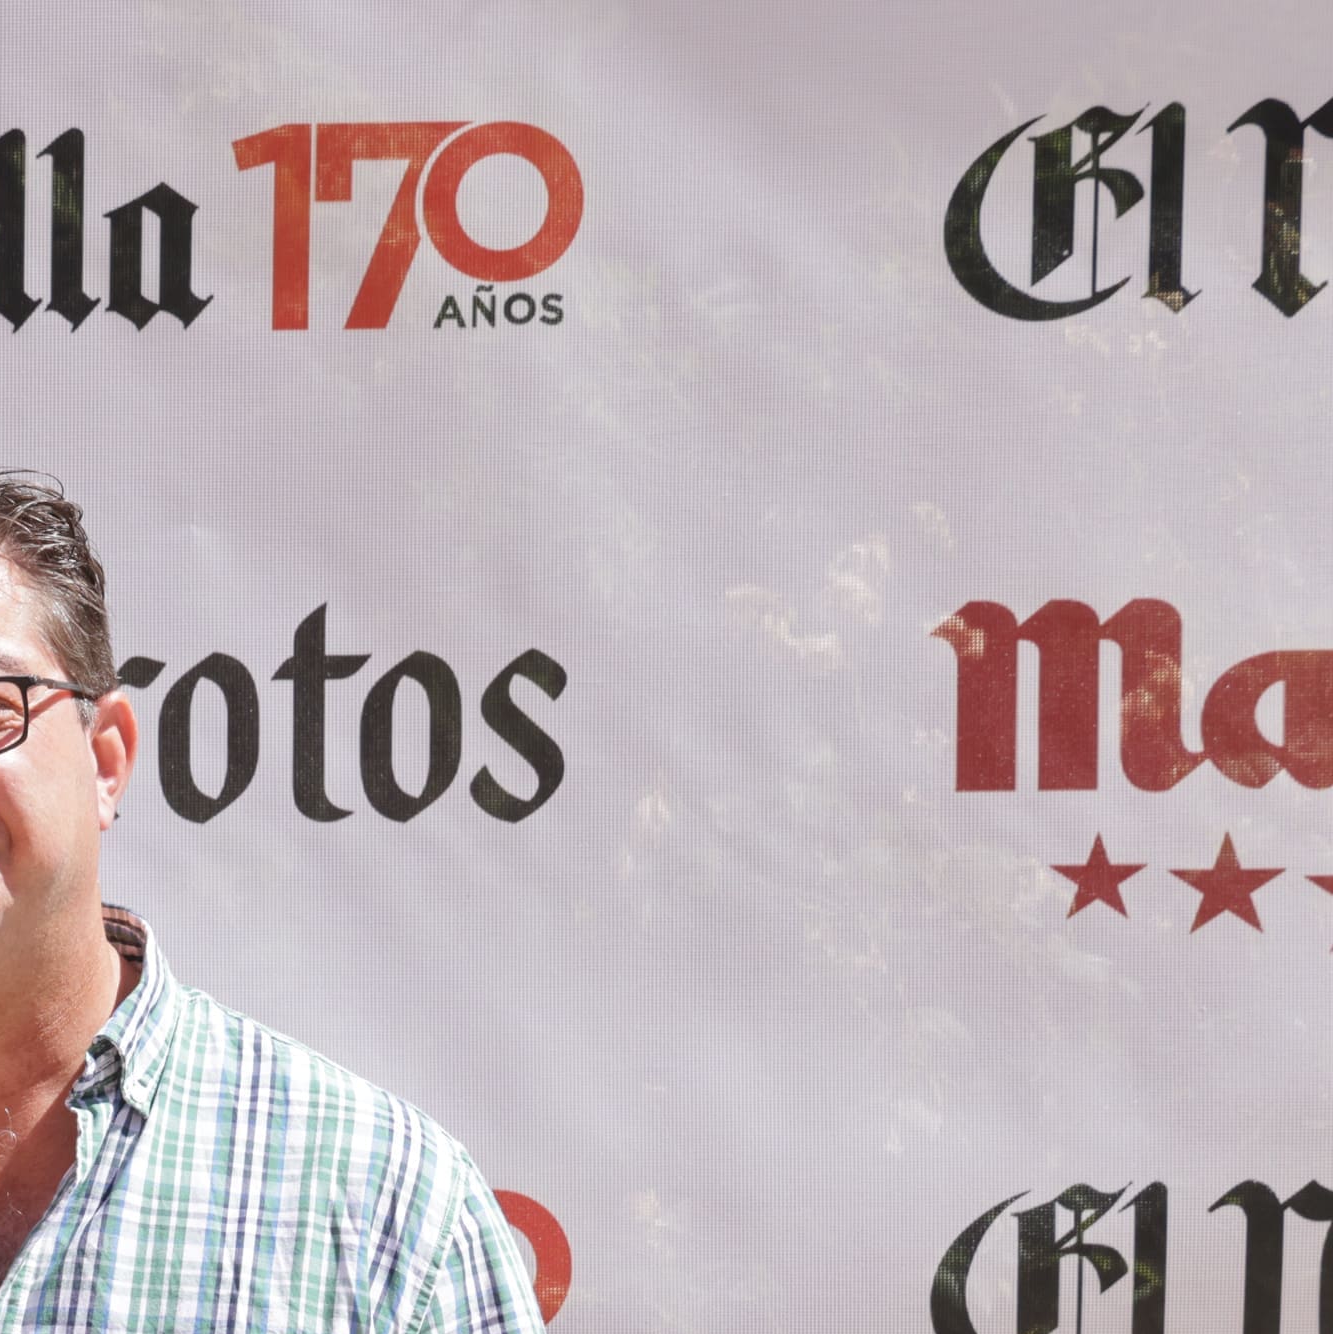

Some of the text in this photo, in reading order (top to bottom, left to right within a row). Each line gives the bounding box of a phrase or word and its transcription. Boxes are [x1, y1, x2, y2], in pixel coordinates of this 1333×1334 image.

[232, 121, 584, 331] 170
[433, 285, 564, 328] AÑOS
[943, 102, 1202, 322] El
